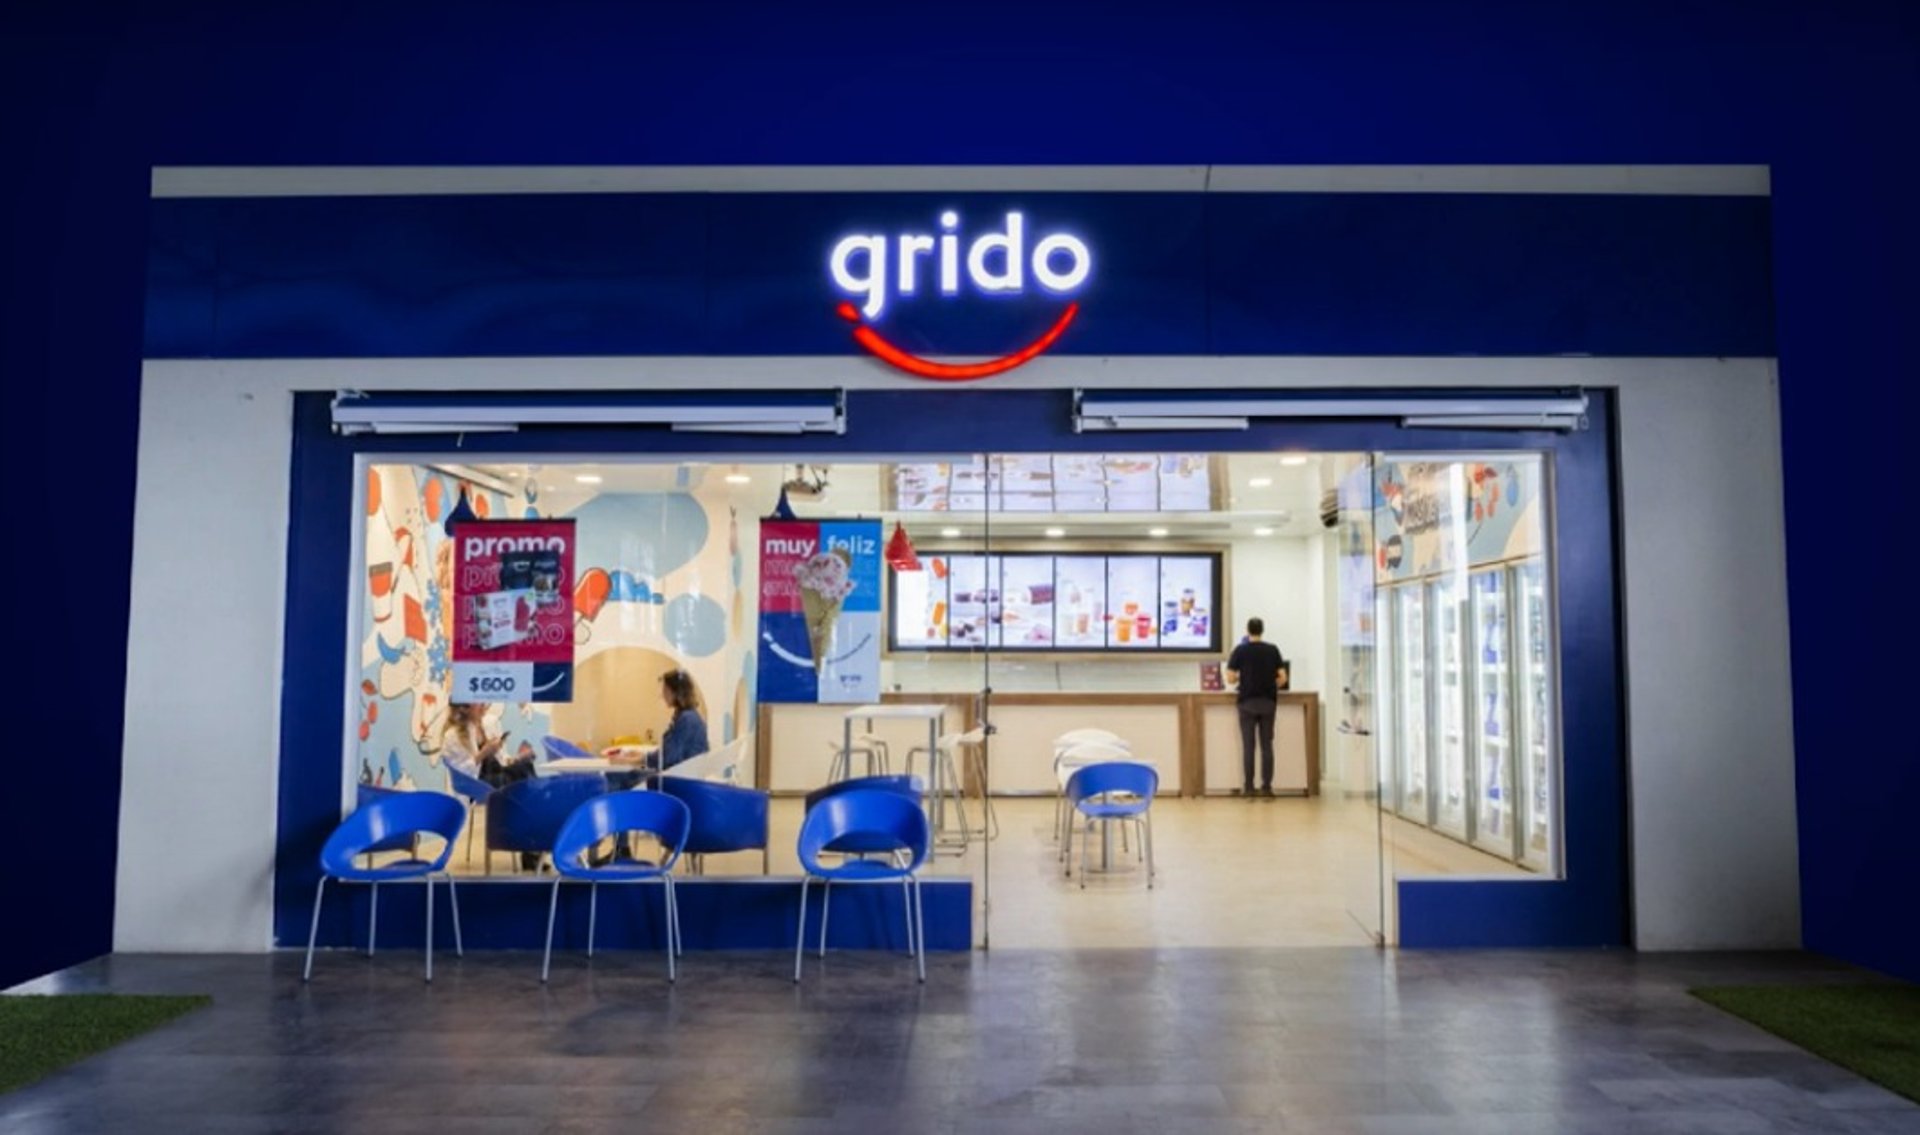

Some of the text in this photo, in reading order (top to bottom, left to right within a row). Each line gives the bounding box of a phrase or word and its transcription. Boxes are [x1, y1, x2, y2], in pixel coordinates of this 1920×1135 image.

[830, 211, 1091, 319] grido
[464, 536, 566, 561] promo
[765, 539, 815, 557] muy
[469, 677, 516, 692] $600
